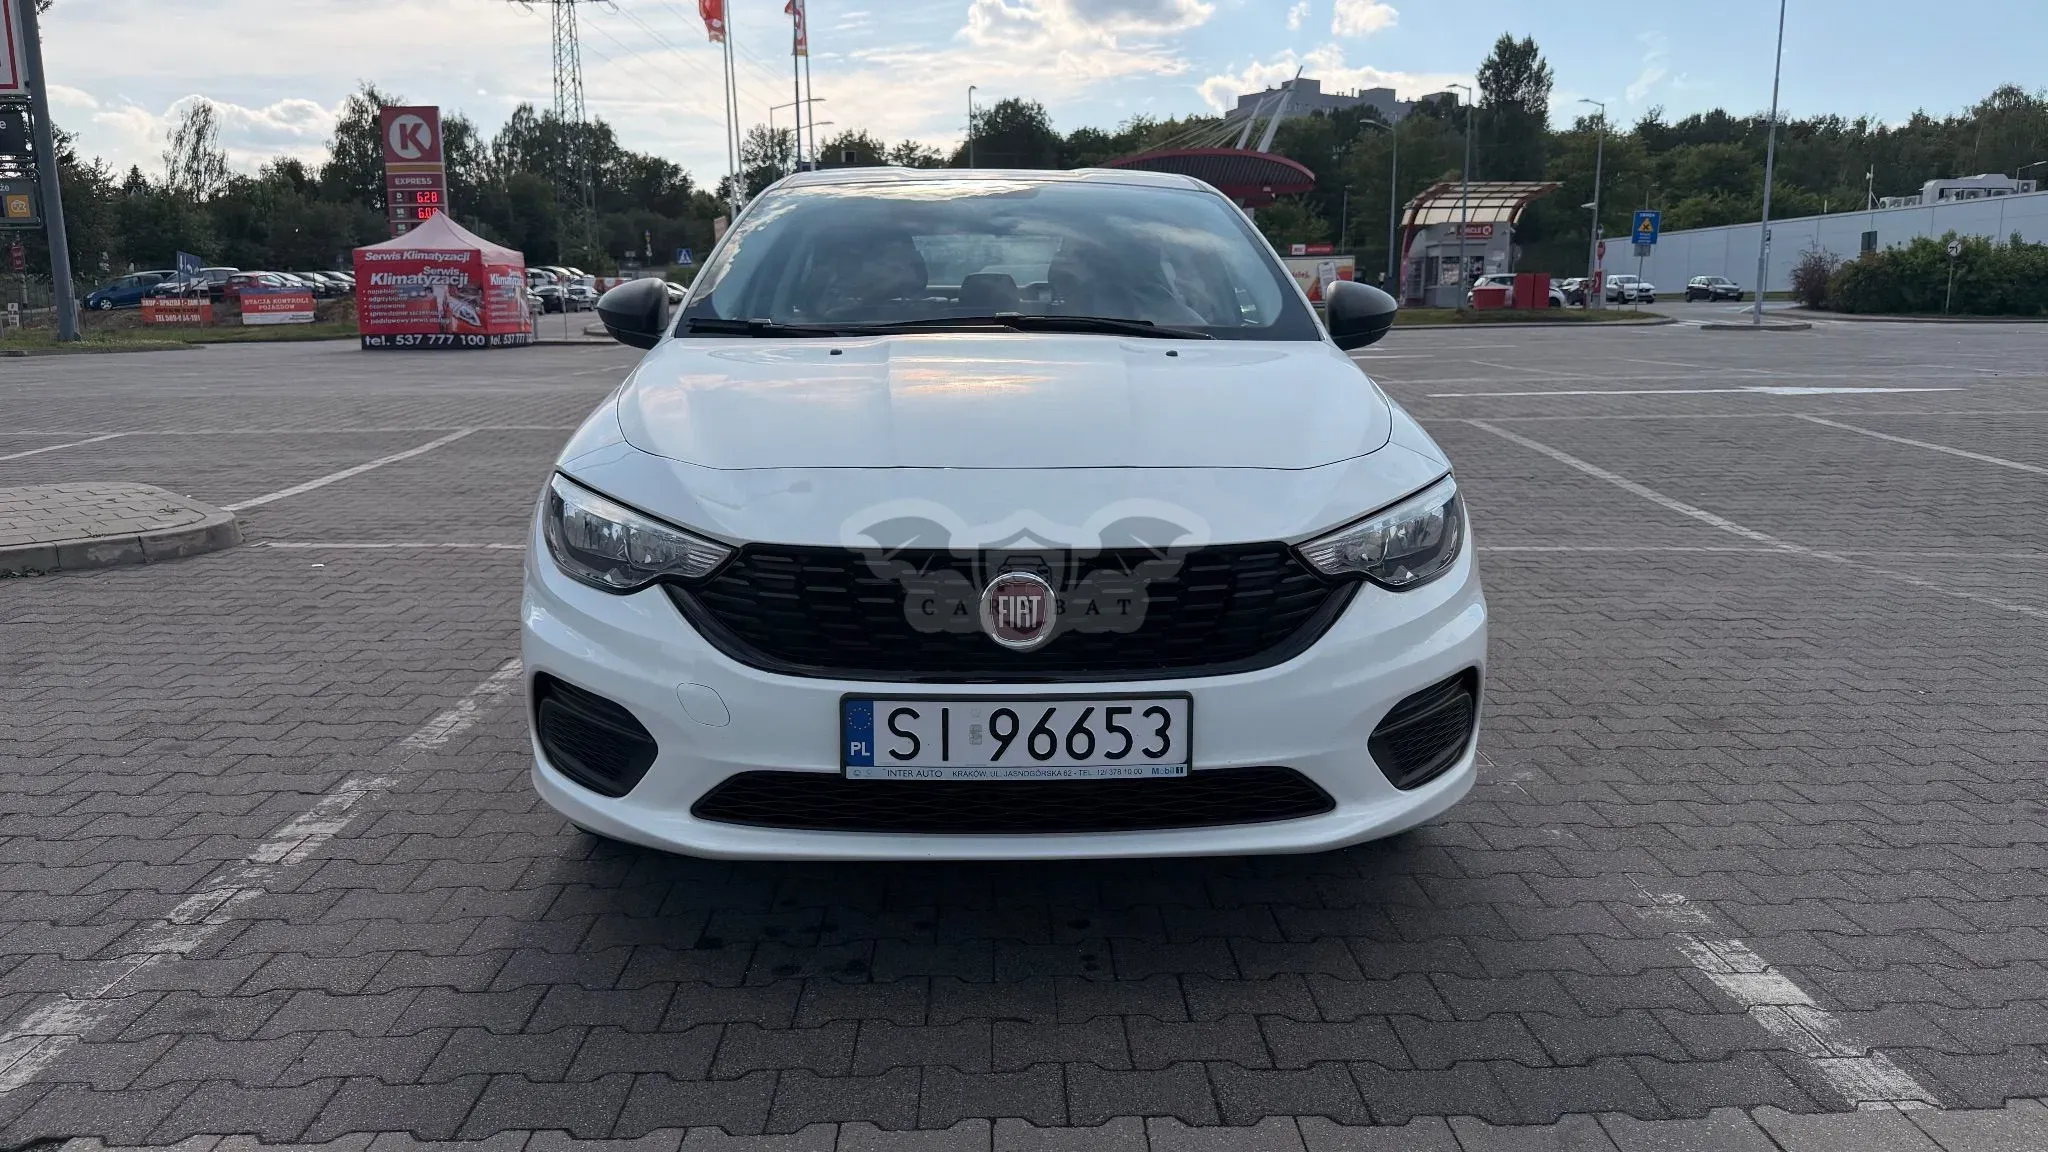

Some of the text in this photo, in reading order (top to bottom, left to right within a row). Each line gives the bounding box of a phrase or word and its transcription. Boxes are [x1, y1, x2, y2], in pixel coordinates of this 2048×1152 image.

[394, 177, 433, 185] EXPRESS
[365, 251, 470, 263] Serwis Klimatyzacji
[423, 265, 460, 276] Serwis
[370, 272, 469, 288] Klimatyzacji
[244, 298, 271, 306] STACJA
[364, 334, 485, 346] tel. 537 777 100
[998, 595, 1042, 628] FIAT
[887, 705, 1172, 762] SI 96653
[850, 741, 870, 757] PL
[886, 769, 943, 778] INTER AUTO
